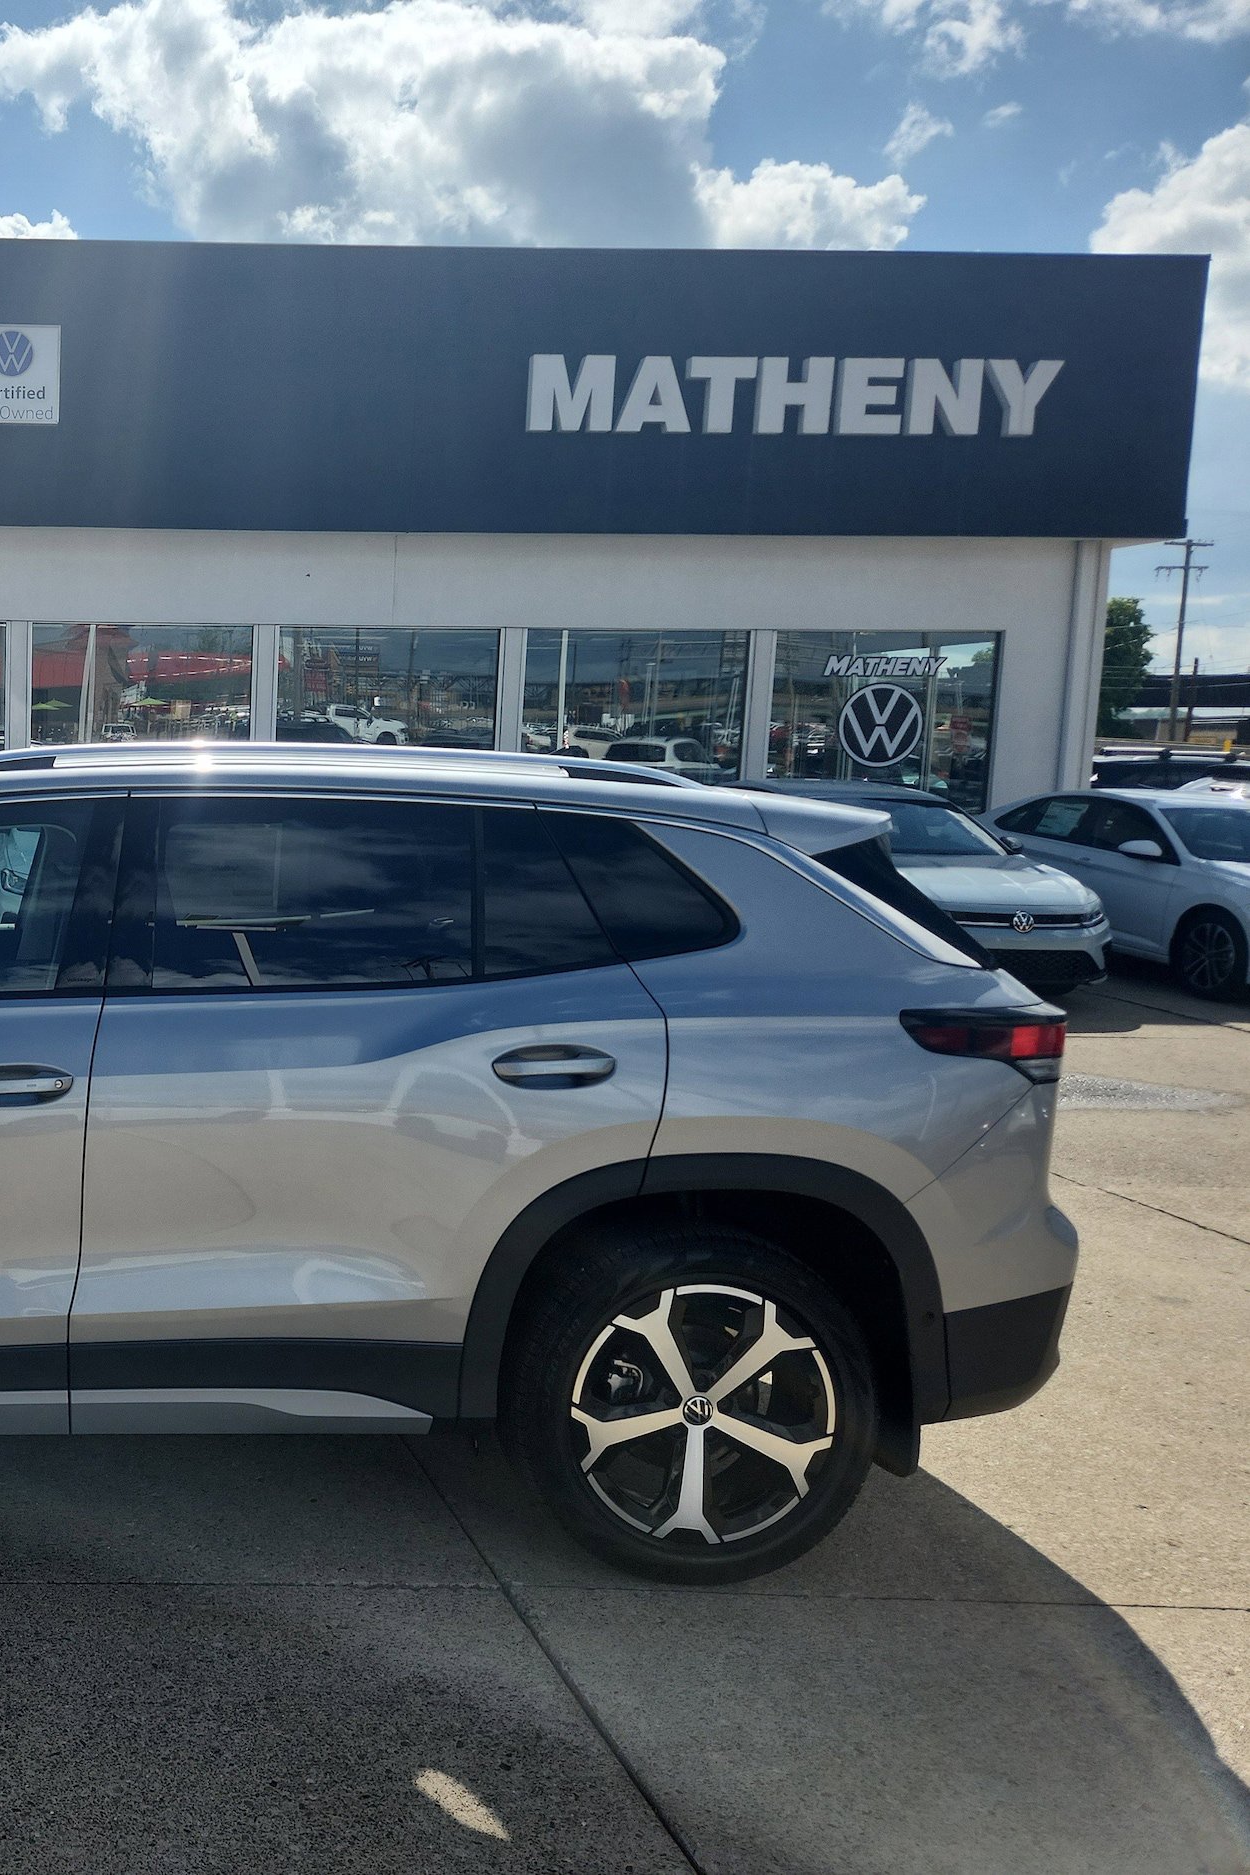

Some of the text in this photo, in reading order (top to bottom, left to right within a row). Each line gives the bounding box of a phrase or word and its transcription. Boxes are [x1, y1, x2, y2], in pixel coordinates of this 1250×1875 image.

[525, 353, 1066, 437] MATHENY
[824, 656, 946, 677] MATHENY
[839, 683, 922, 767] VW
[1011, 910, 1035, 934] VW
